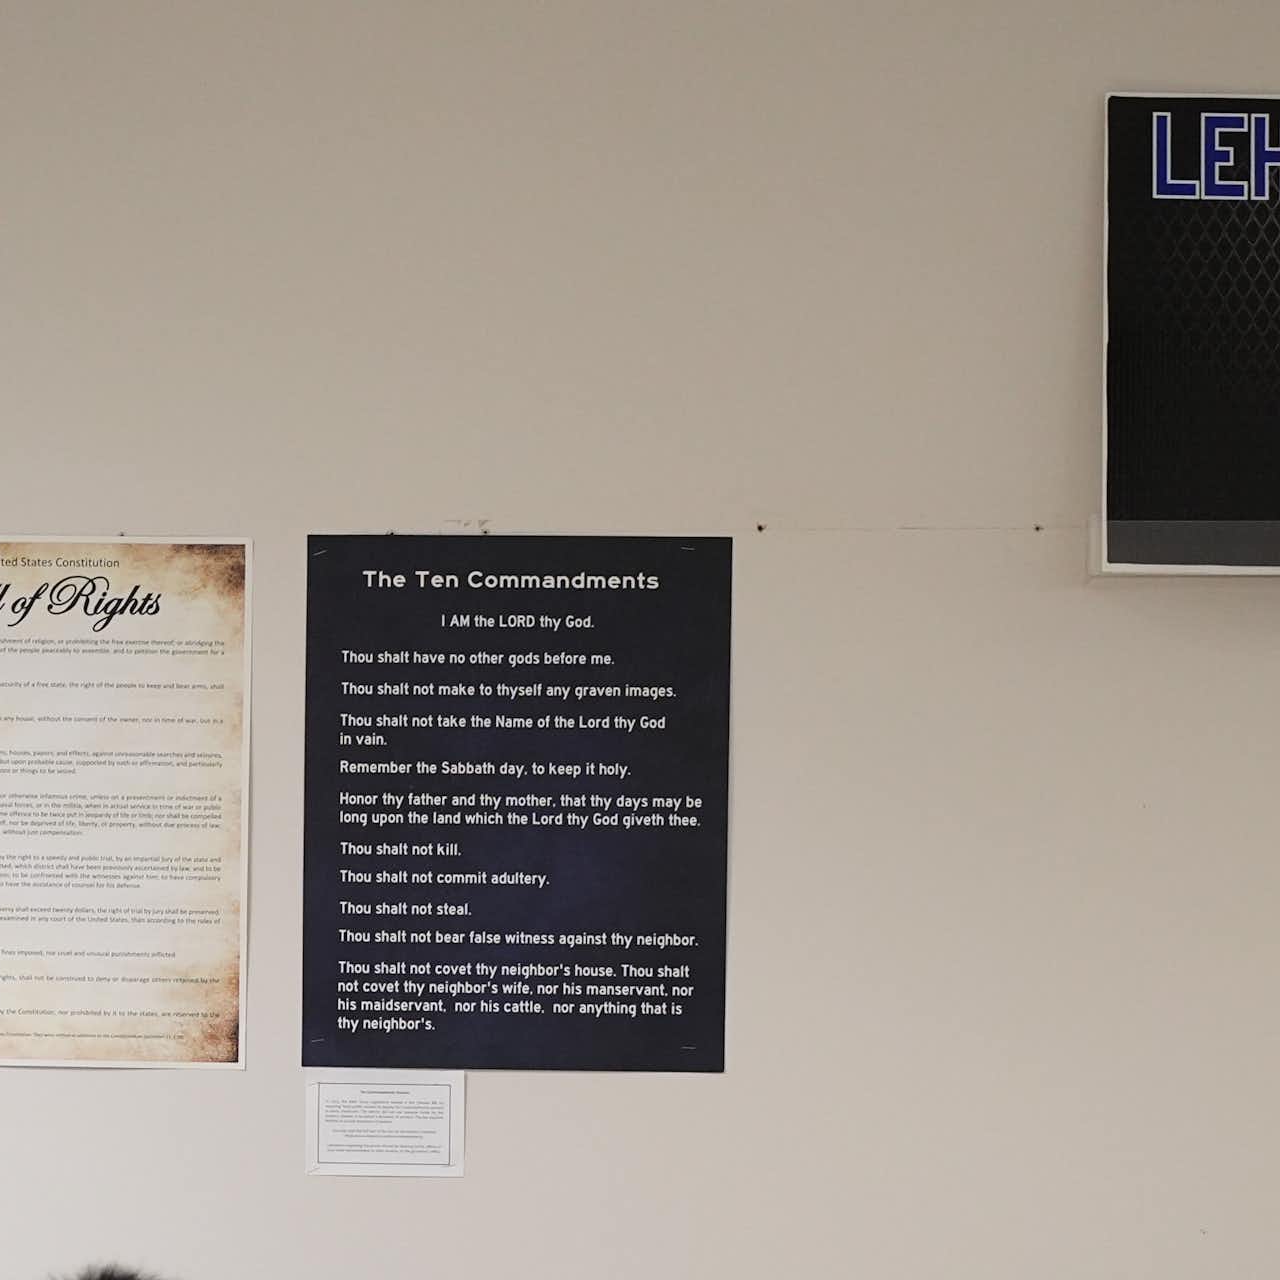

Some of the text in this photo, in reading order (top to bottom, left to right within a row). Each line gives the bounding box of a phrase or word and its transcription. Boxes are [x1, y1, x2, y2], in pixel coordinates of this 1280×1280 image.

[21, 557, 53, 567] States
[55, 557, 120, 568] Constitution
[362, 570, 659, 589] The Ten Commandments
[7, 582, 49, 628] of
[47, 575, 162, 632] Rights
[442, 614, 594, 631] I AM the LORD thy God.
[341, 650, 614, 668] Thou shalt have no other gods before me.
[341, 682, 676, 700] Thou shalt not make to thyself any graven images.
[340, 713, 666, 732] Thou shalt not take the Name of the Lord thy God
[340, 732, 387, 745] in vain.
[340, 760, 412, 773] Remember
[416, 761, 437, 774] the
[441, 761, 495, 774] Sabbath
[532, 762, 545, 775] to
[549, 762, 581, 778] keep
[586, 762, 595, 775] it
[599, 763, 631, 779] holy.
[340, 792, 378, 805] Honor
[382, 792, 404, 809] thy
[408, 793, 447, 806] father
[452, 793, 476, 806] and
[479, 794, 502, 810] thy
[560, 794, 586, 807] that
[590, 795, 612, 811] thy
[616, 795, 648, 811] days
[652, 798, 682, 811] may
[686, 796, 702, 808] be
[340, 810, 700, 829] long upon the land which the Lord thy God giveth thee.
[340, 842, 461, 856] Thou shalt not kill.
[339, 901, 472, 915] Thou shalt not steal.
[339, 929, 698, 949] Thou shalt not bear false witness against thy neighbor.
[338, 961, 690, 979] Thou shalt not covet thy neighbor's house. Thou shalt
[338, 998, 357, 1011] his
[455, 1002, 477, 1012] nor
[480, 1000, 500, 1012] his
[553, 1003, 575, 1013] nor
[579, 1001, 636, 1017] anything
[641, 1002, 667, 1015] that
[671, 1002, 682, 1015] is
[337, 1016, 435, 1033] thy neighbor's.
